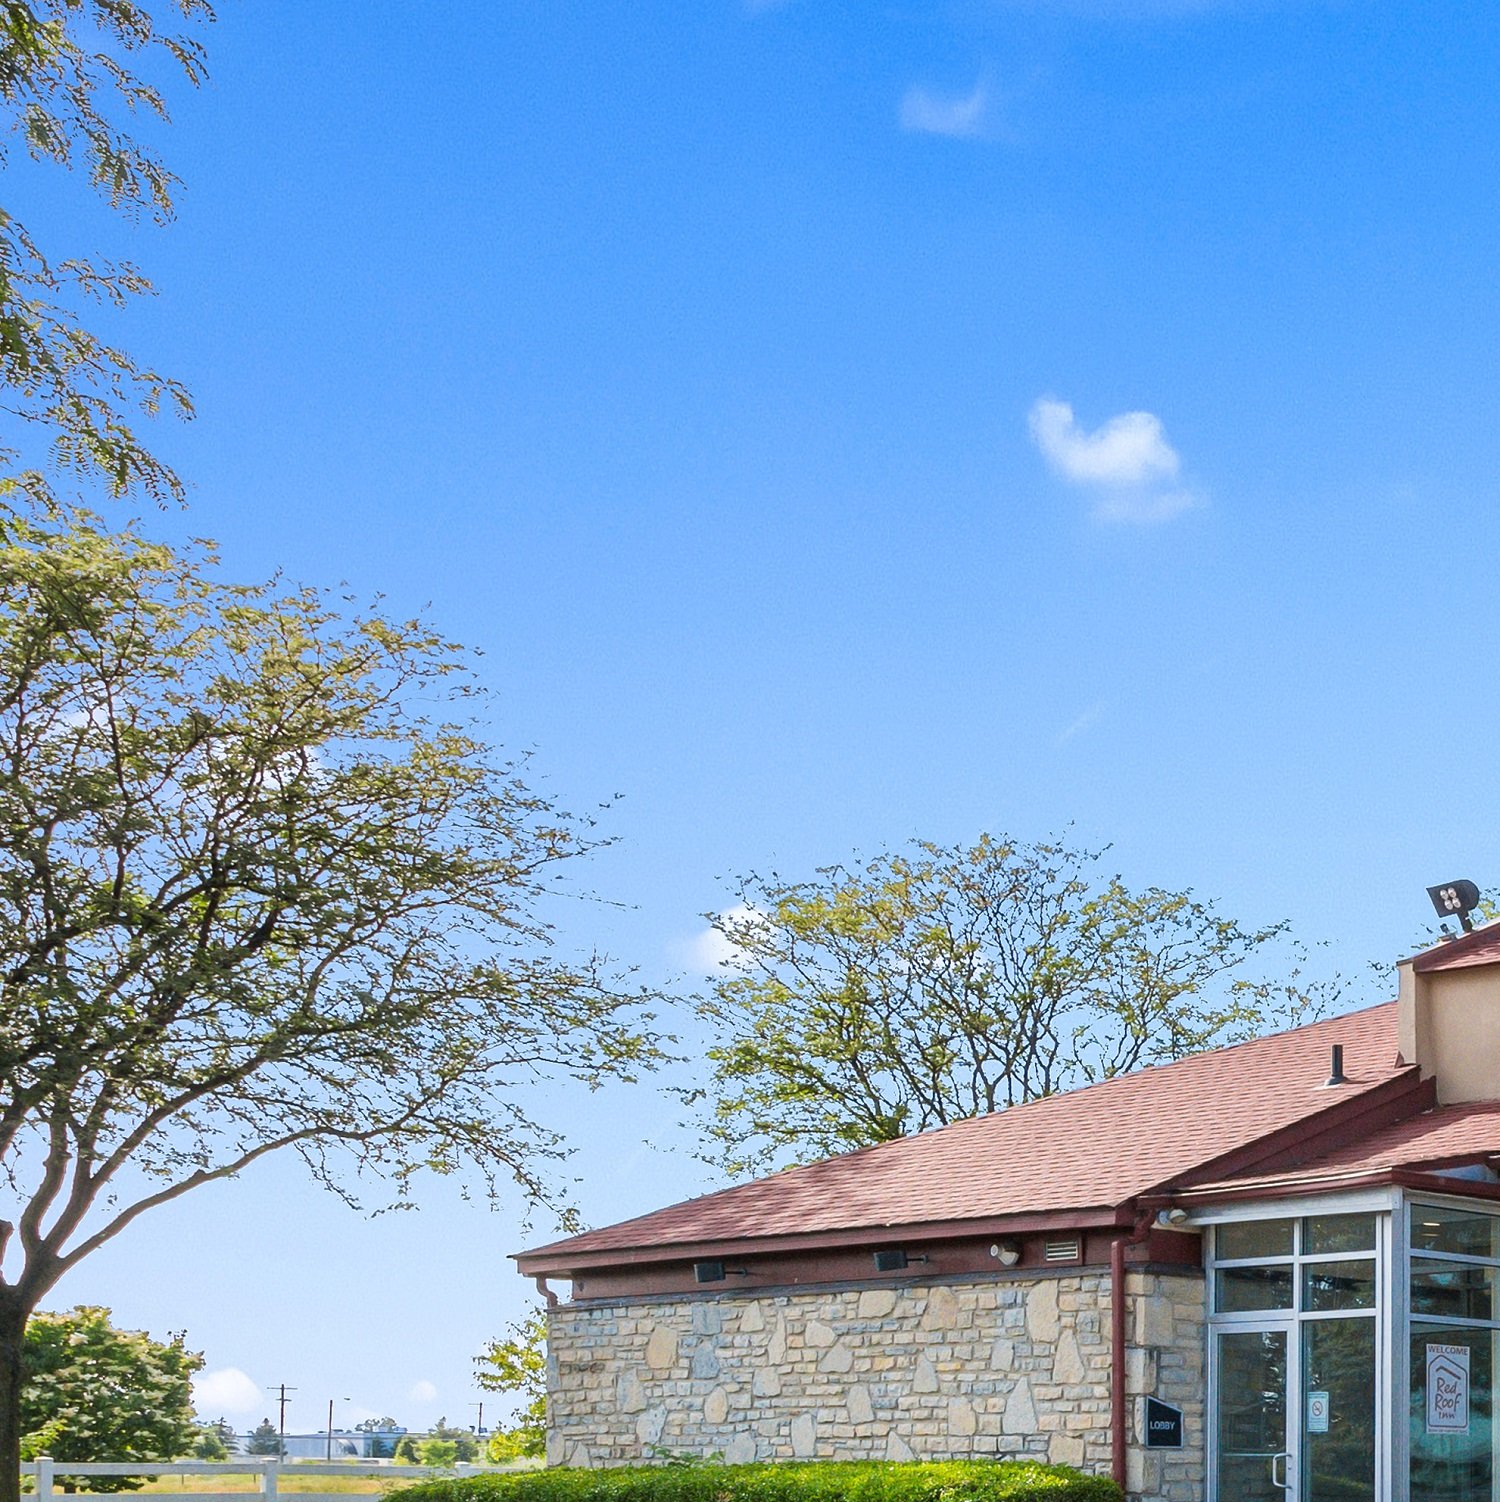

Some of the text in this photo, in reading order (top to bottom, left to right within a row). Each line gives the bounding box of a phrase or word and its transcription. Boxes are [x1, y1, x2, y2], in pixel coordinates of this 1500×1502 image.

[1428, 1345, 1468, 1355] WELCOME
[1437, 1377, 1457, 1394] Red
[1435, 1393, 1462, 1412] Roof
[1150, 1421, 1175, 1430] LOBBY
